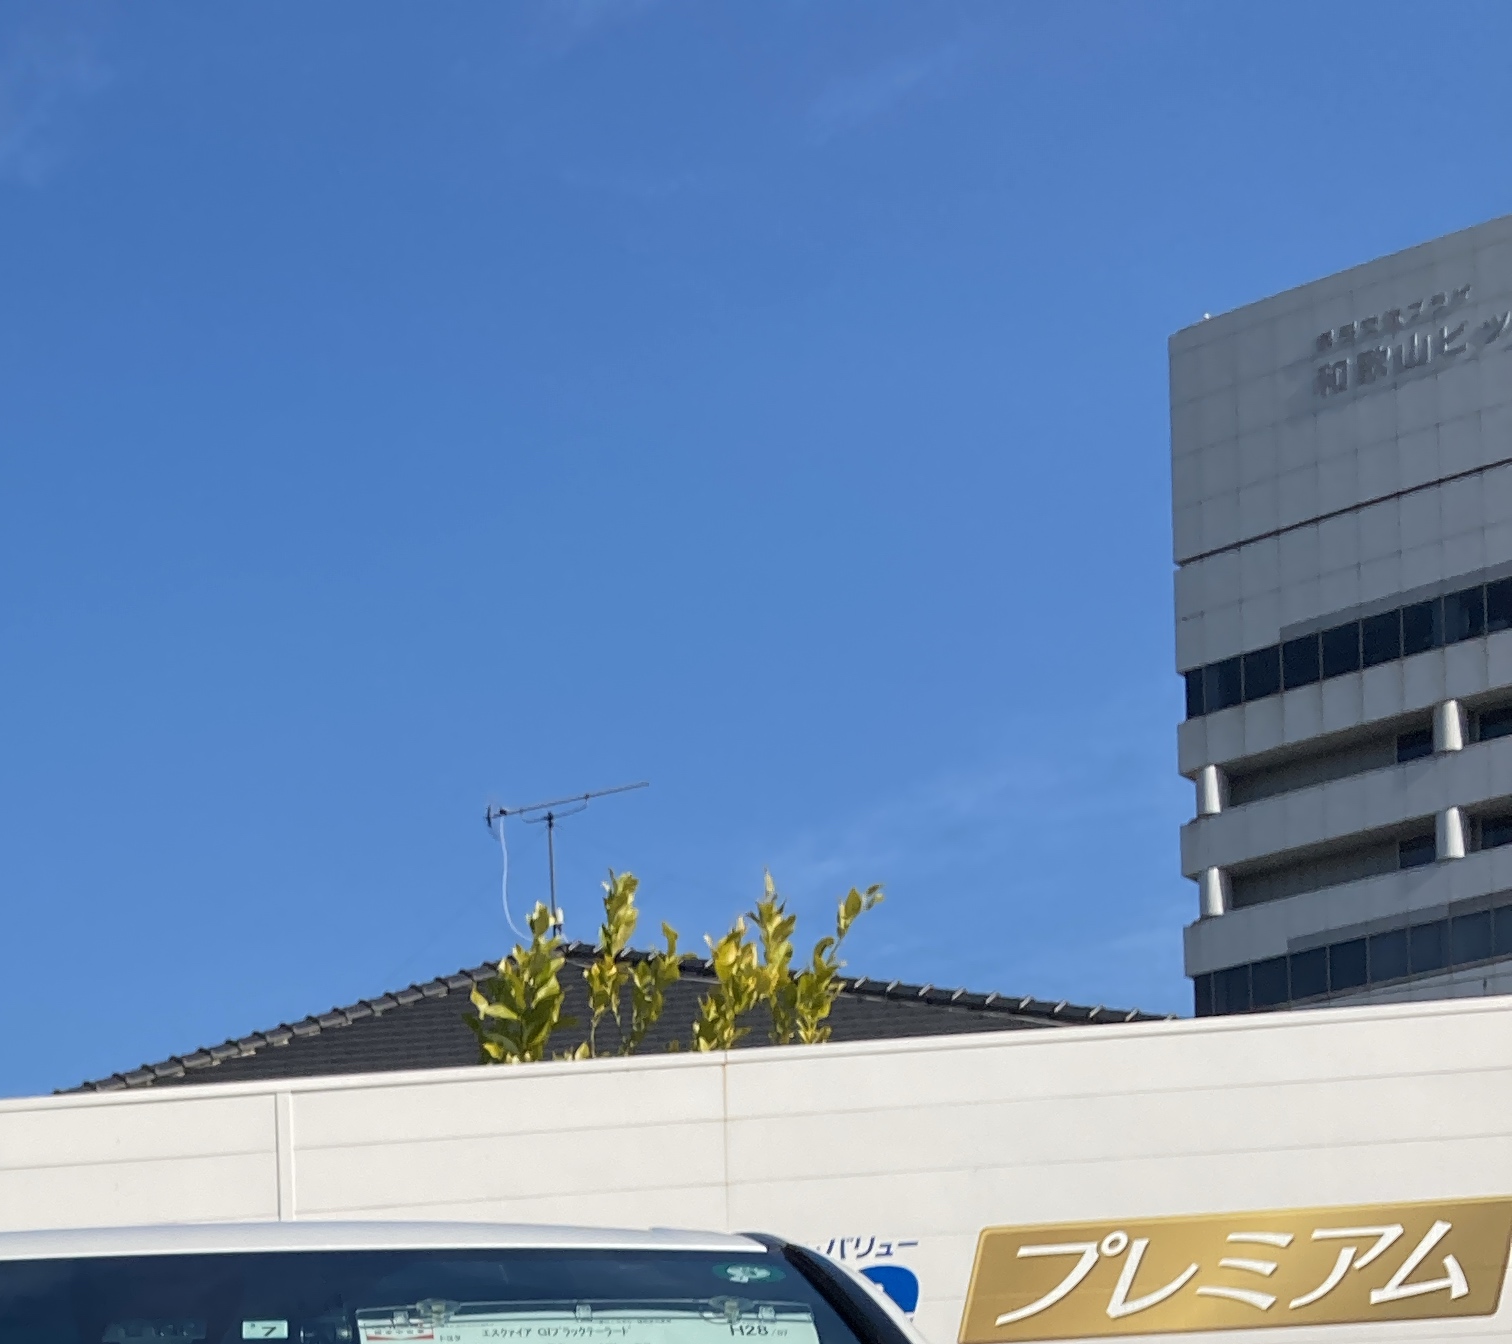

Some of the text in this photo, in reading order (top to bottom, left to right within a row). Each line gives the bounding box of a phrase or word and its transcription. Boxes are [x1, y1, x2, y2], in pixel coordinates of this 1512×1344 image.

[994, 1220, 1471, 1328] プレミアム
